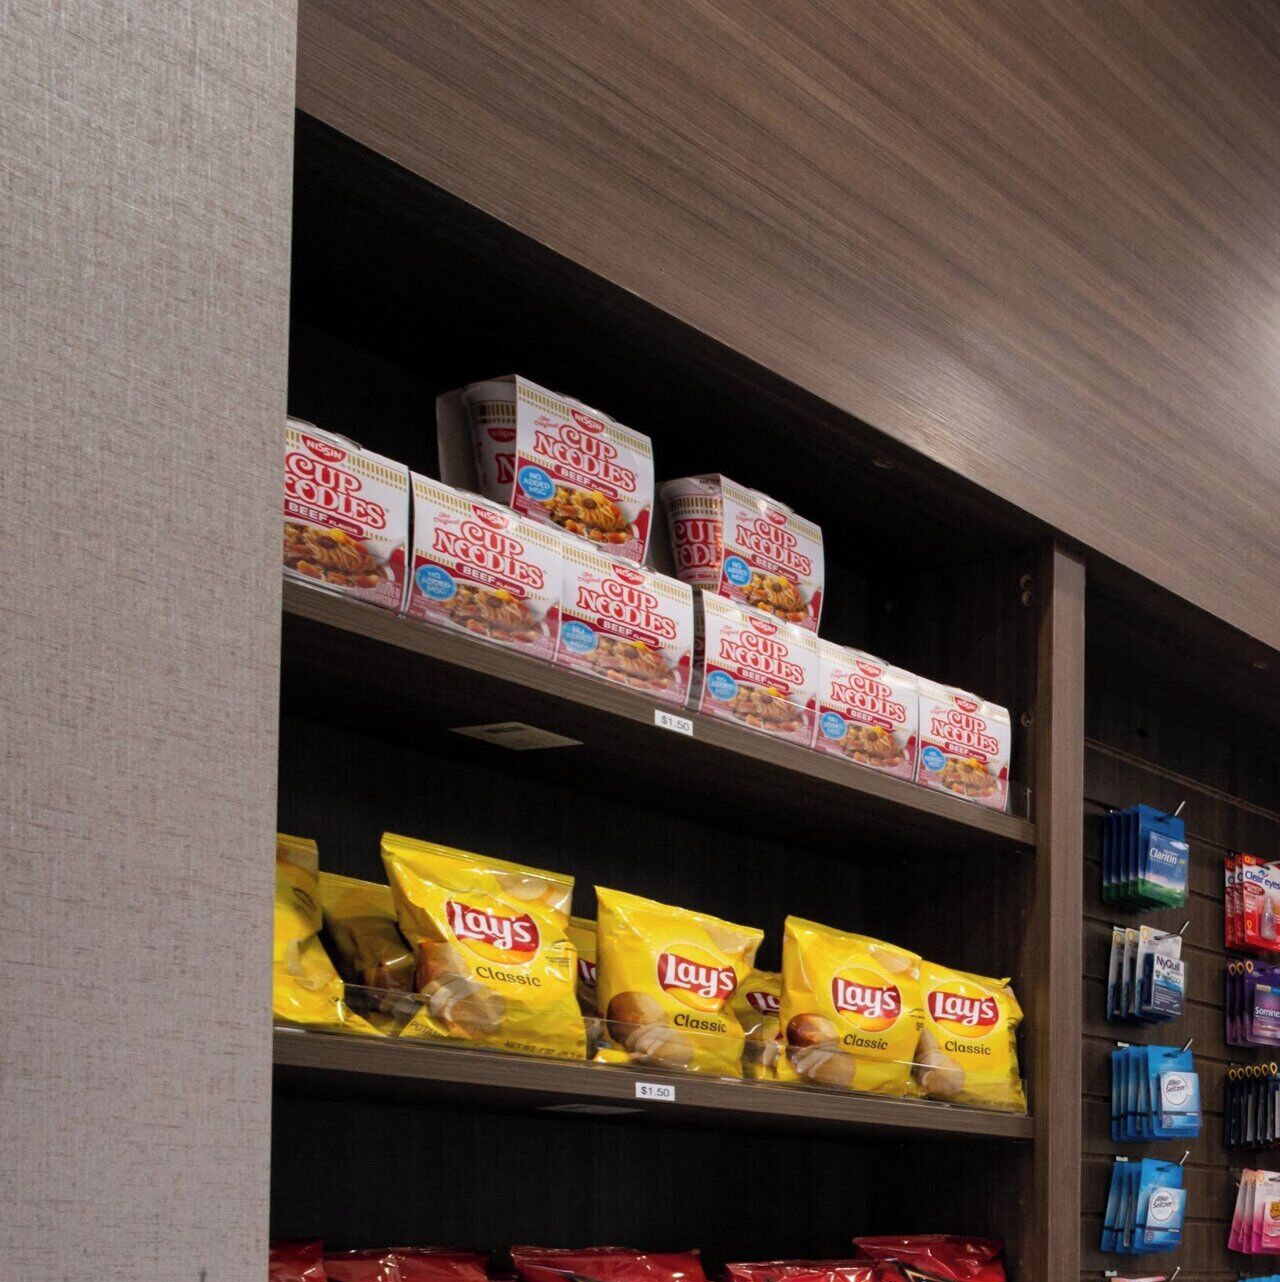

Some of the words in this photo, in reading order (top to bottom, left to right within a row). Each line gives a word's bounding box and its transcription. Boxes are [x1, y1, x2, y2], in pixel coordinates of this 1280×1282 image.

[575, 413, 600, 429] NISSIN
[306, 439, 343, 461] NISSIN
[559, 424, 618, 461] CUP
[286, 453, 362, 492] CUP
[533, 430, 636, 492] NOODLES
[561, 468, 591, 486] BEEF
[285, 472, 386, 529] OODLES
[288, 501, 329, 522] BEEF
[328, 518, 359, 535] FLAVOR
[460, 521, 524, 556] CUP
[754, 518, 797, 549] CUP
[432, 527, 544, 589] NOODLES
[735, 524, 812, 576] NOODLES
[755, 557, 779, 571] BEEF
[462, 565, 496, 583] BEEF
[602, 579, 658, 610] CUP
[576, 585, 677, 640] NOODLES
[603, 621, 633, 636] BEEF
[740, 631, 788, 660] CUP
[719, 638, 805, 685] NOODLES
[742, 670, 767, 682] BEEF
[849, 673, 892, 701] CUP
[831, 682, 906, 723] NOODLES
[851, 709, 873, 722] BEEF
[660, 716, 690, 732] $1.50
[931, 717, 999, 755] NOODLES
[947, 709, 986, 735] CUP
[948, 744, 969, 756] BEEF
[1149, 847, 1177, 864] Claritin
[1245, 870, 1264, 883] Clear
[1264, 877, 1280, 890] eyes
[452, 901, 531, 949] Lay's
[475, 966, 542, 987] Classic
[664, 954, 735, 998] Lay's
[1156, 955, 1181, 971] NyQuil
[837, 979, 897, 1018] Lay's
[934, 992, 994, 1026] Lay's
[673, 1013, 728, 1033] Classic
[843, 1034, 889, 1051] Classic
[944, 1040, 992, 1056] Classic
[640, 1085, 671, 1099] $1.50
